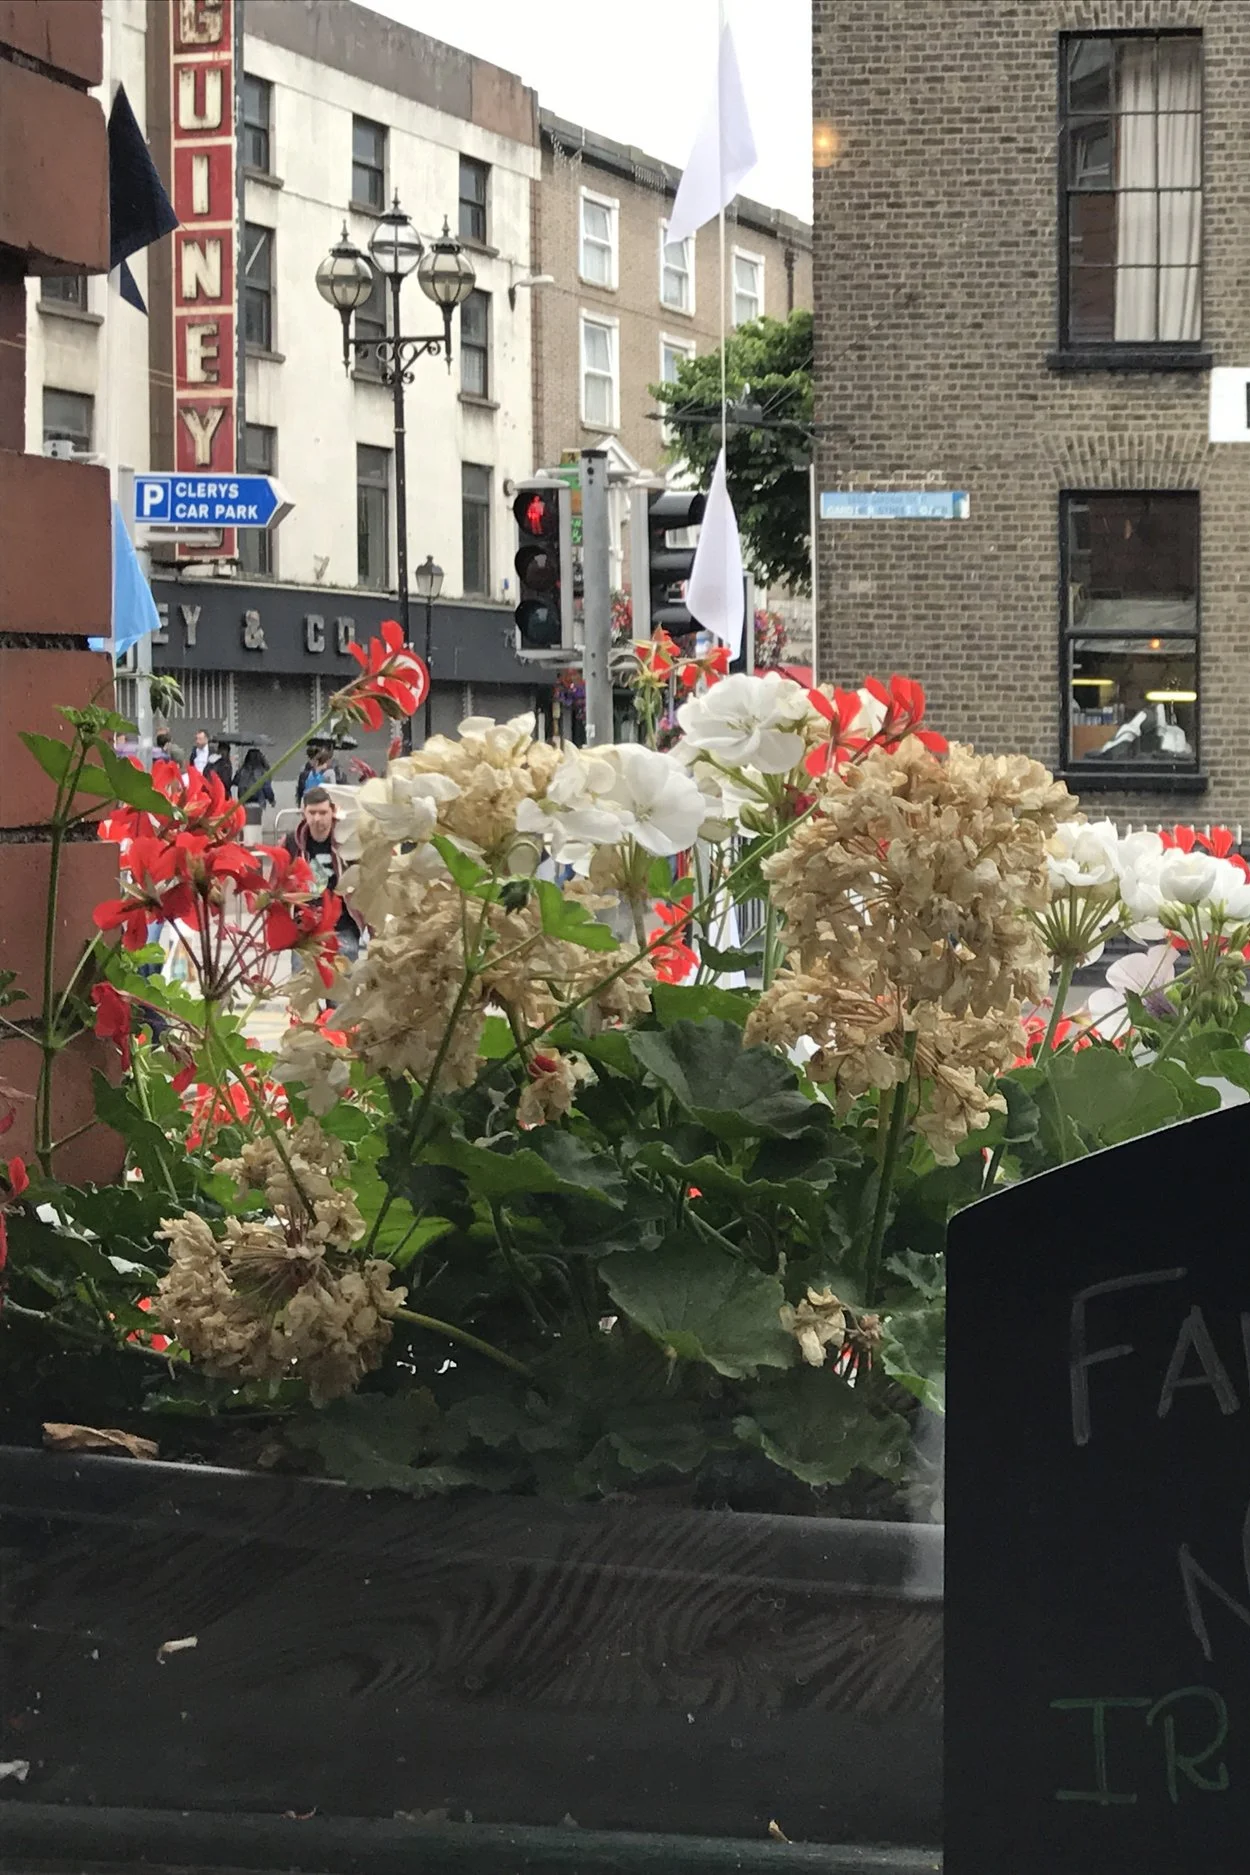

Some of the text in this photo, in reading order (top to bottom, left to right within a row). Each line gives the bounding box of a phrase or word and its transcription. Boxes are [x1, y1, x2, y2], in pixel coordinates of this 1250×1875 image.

[178, 0, 224, 547] GUINEY
[143, 484, 164, 516] P
[175, 482, 239, 498] CLERYS
[175, 504, 258, 519] CAR PARK
[244, 609, 268, 649] &
